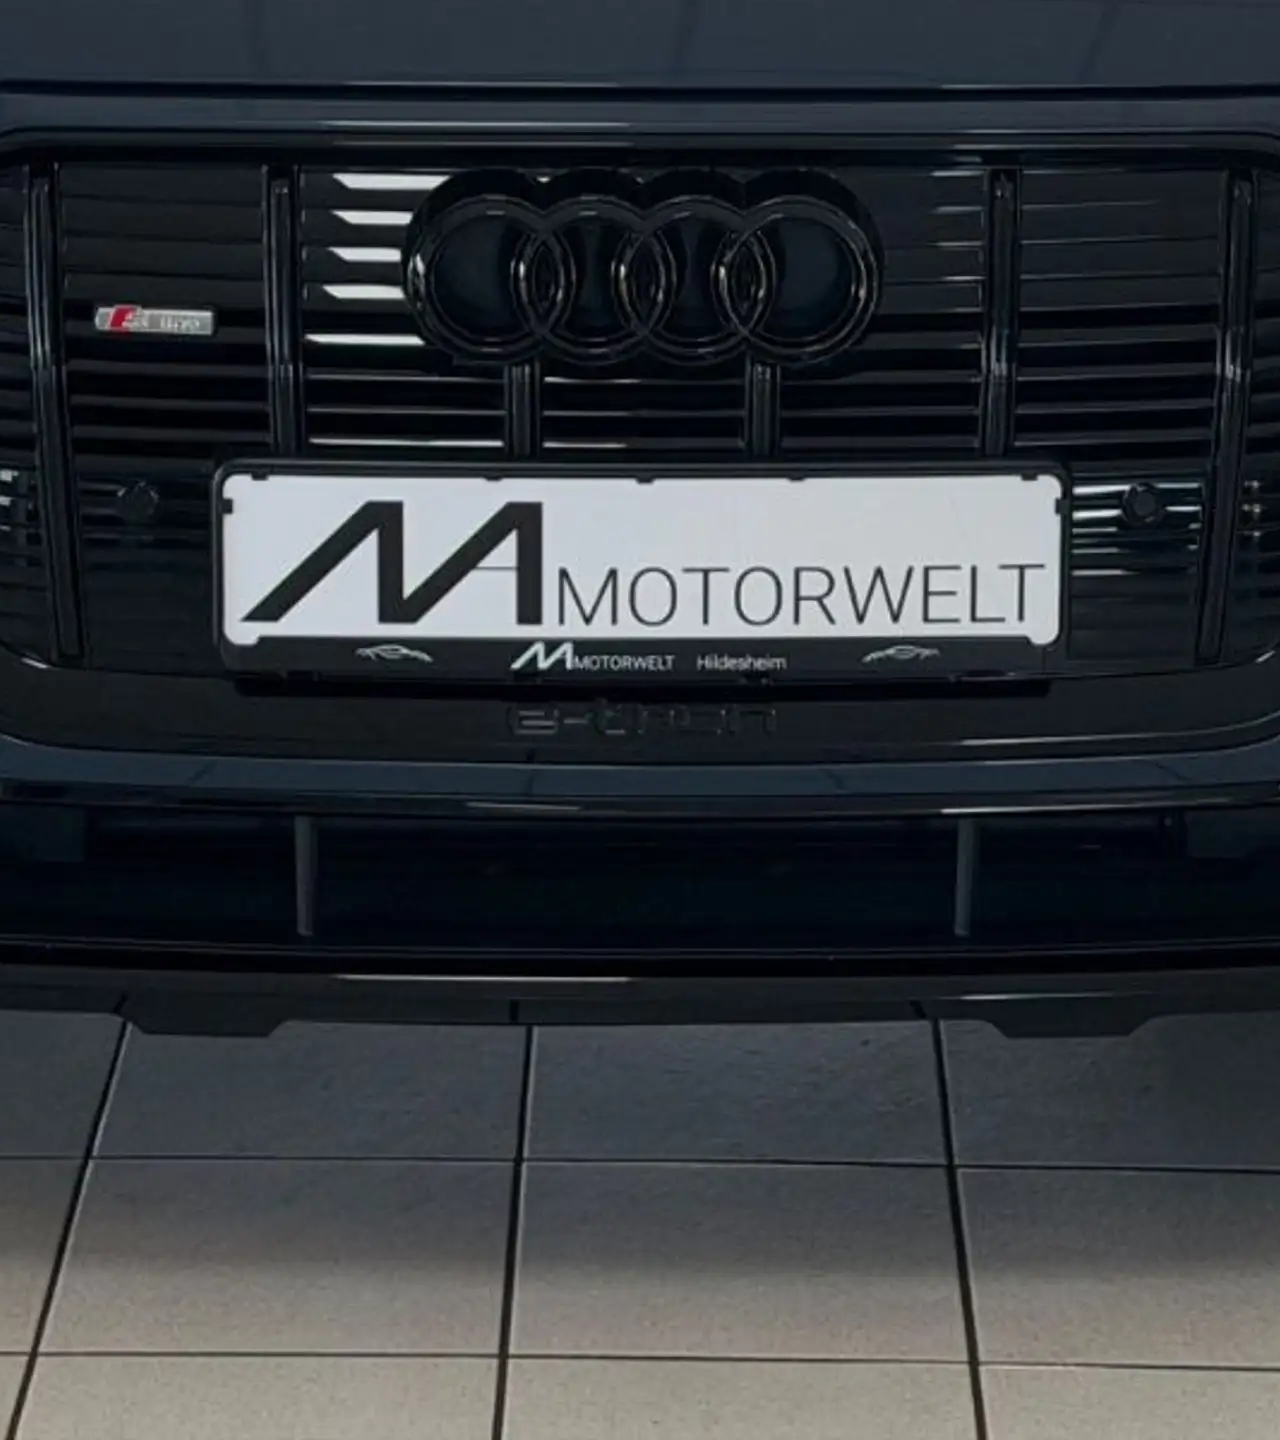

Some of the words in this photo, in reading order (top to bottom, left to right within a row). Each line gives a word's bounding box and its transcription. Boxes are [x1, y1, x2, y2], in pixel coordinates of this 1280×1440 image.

[558, 563, 1046, 627] MOTORWELT
[575, 655, 676, 671] MOTORWELT
[696, 654, 788, 671] Hildesheim
